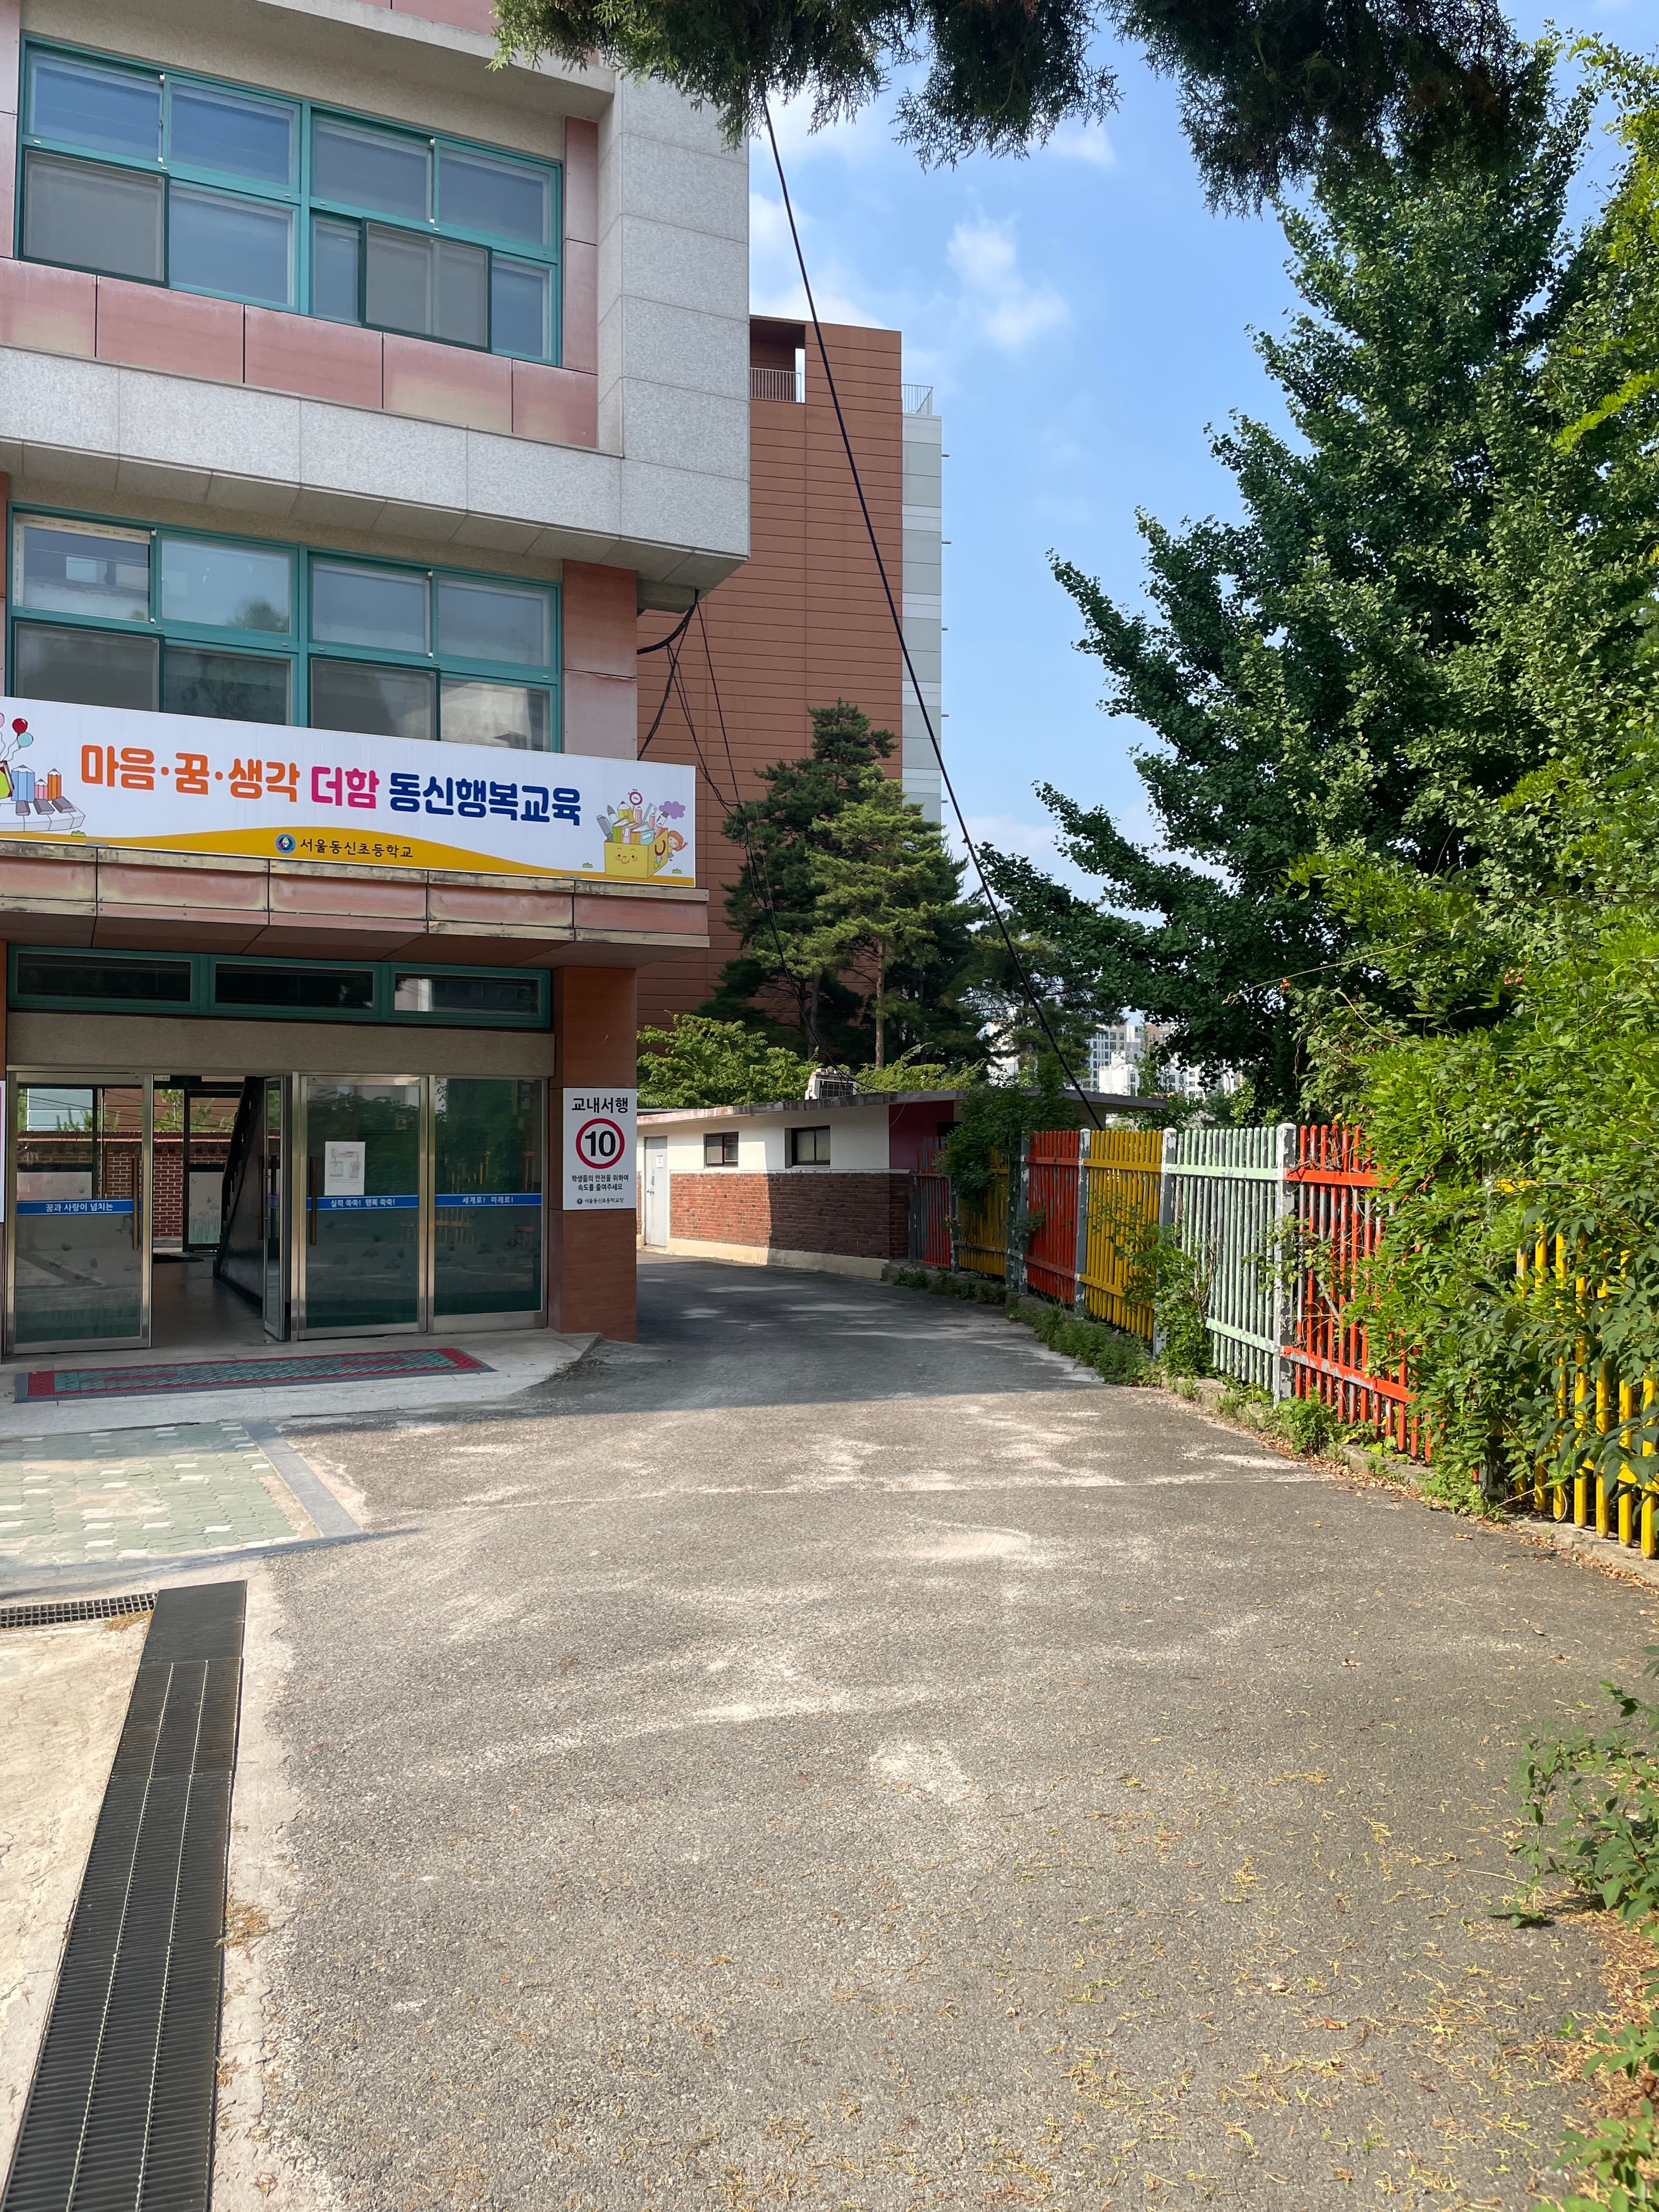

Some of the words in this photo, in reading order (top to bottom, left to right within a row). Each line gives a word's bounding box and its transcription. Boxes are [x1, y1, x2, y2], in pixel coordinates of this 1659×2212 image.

[81, 744, 300, 803] 마음·꿈·생각
[311, 766, 380, 809] 더함
[389, 772, 581, 826] 동신행복교육
[300, 838, 413, 859] 서울동신초등학교
[572, 1097, 629, 1114] 교내서행
[585, 1131, 616, 1156] 10
[572, 1175, 594, 1183] 학생들의
[596, 1183, 623, 1192] 줄여주세요
[46, 1203, 62, 1212] 꿈과
[64, 1203, 87, 1212] 사랑이
[90, 1202, 114, 1211] 넘치는
[331, 1199, 343, 1207] 실력
[365, 1199, 378, 1207] 행복
